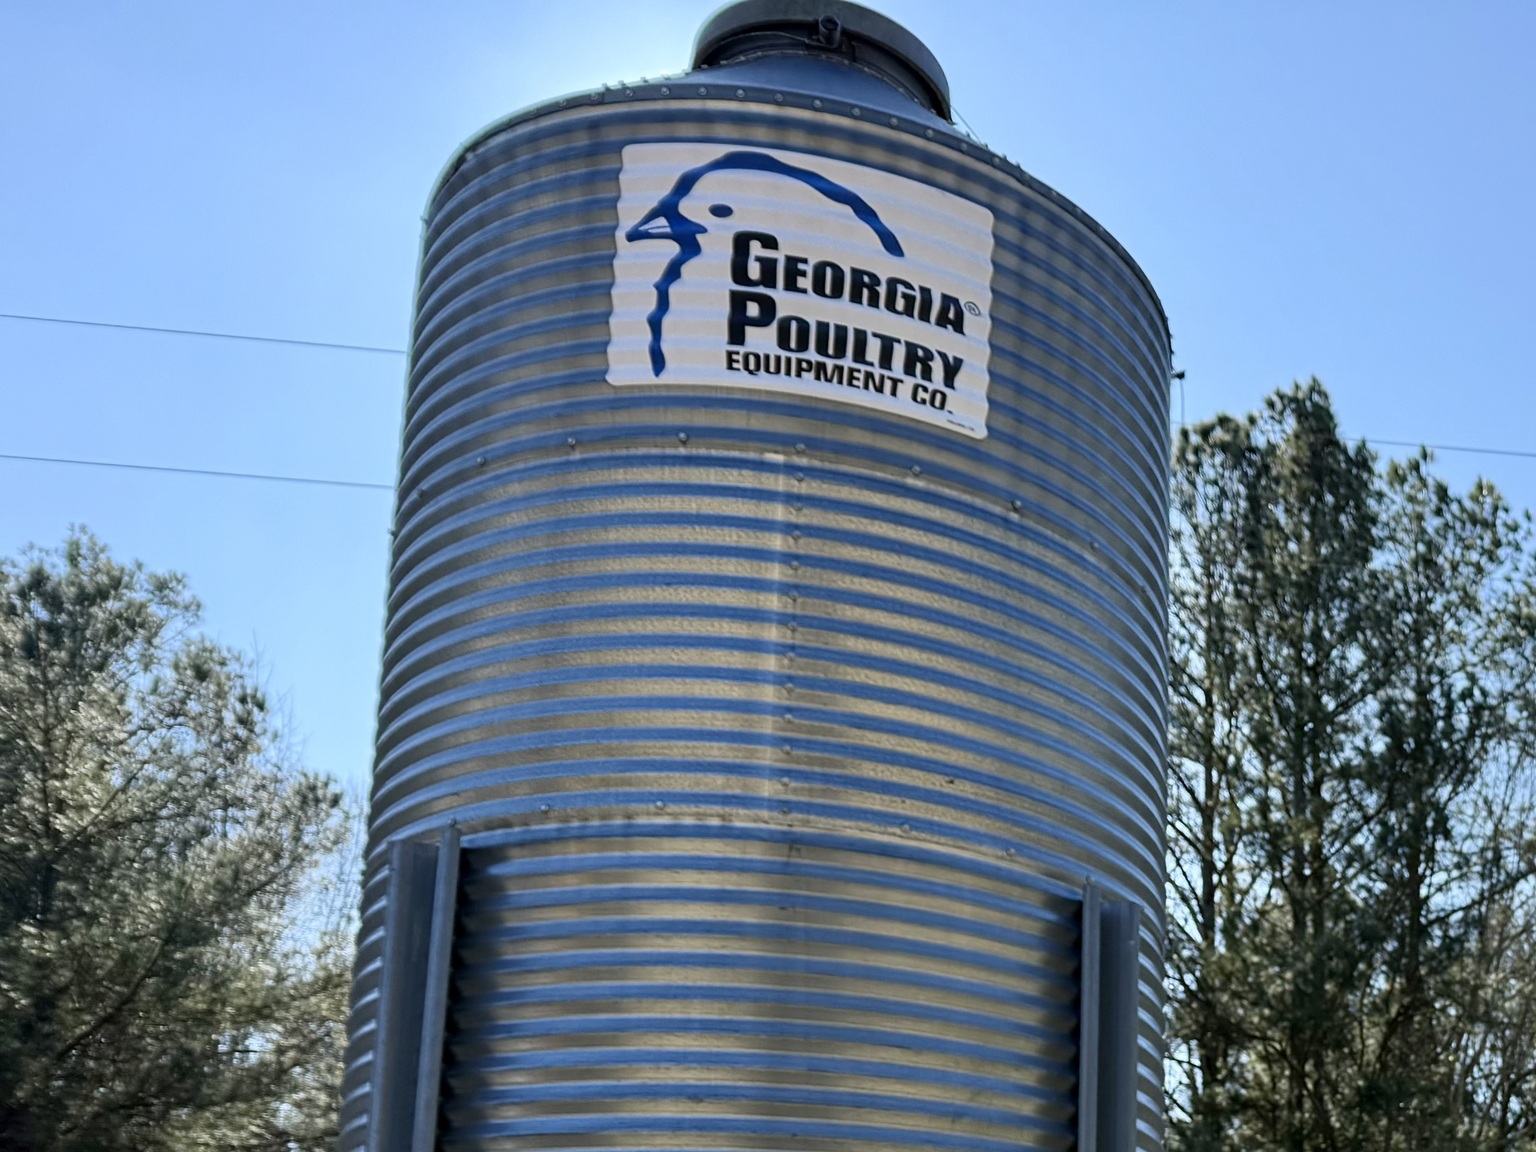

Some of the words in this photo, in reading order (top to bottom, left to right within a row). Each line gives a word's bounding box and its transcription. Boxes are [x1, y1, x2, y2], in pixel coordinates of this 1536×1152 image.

[730, 230, 966, 337] GEORGIA
[725, 350, 904, 399] EQUIPMENT
[910, 383, 954, 416] CO.
[726, 289, 964, 390] POULTRY
